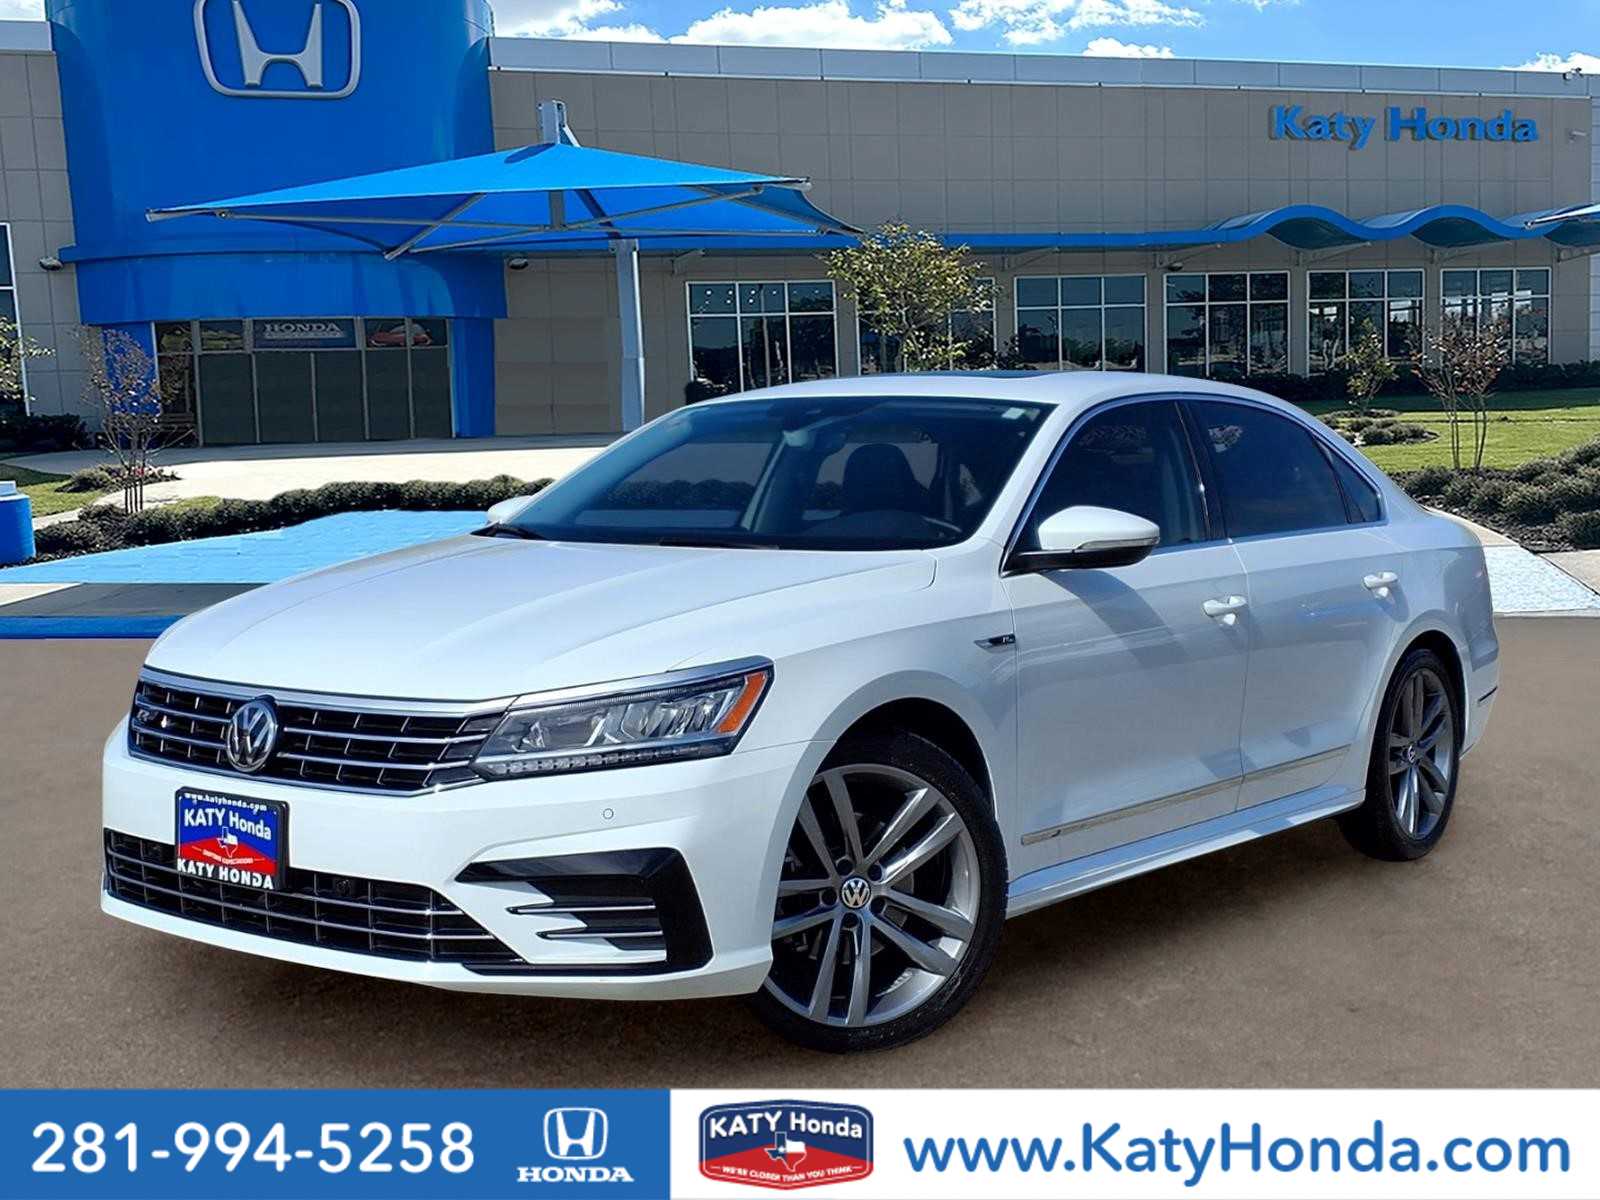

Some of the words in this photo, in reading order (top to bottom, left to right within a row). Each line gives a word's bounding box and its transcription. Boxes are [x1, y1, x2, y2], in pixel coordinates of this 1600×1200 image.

[1269, 104, 1376, 150] Katy
[1384, 106, 1539, 142] Honda
[263, 322, 341, 333] HONDA
[184, 808, 226, 827] KATY
[228, 810, 272, 840] Honda
[177, 859, 215, 878] KATY
[218, 867, 274, 890] HONDA
